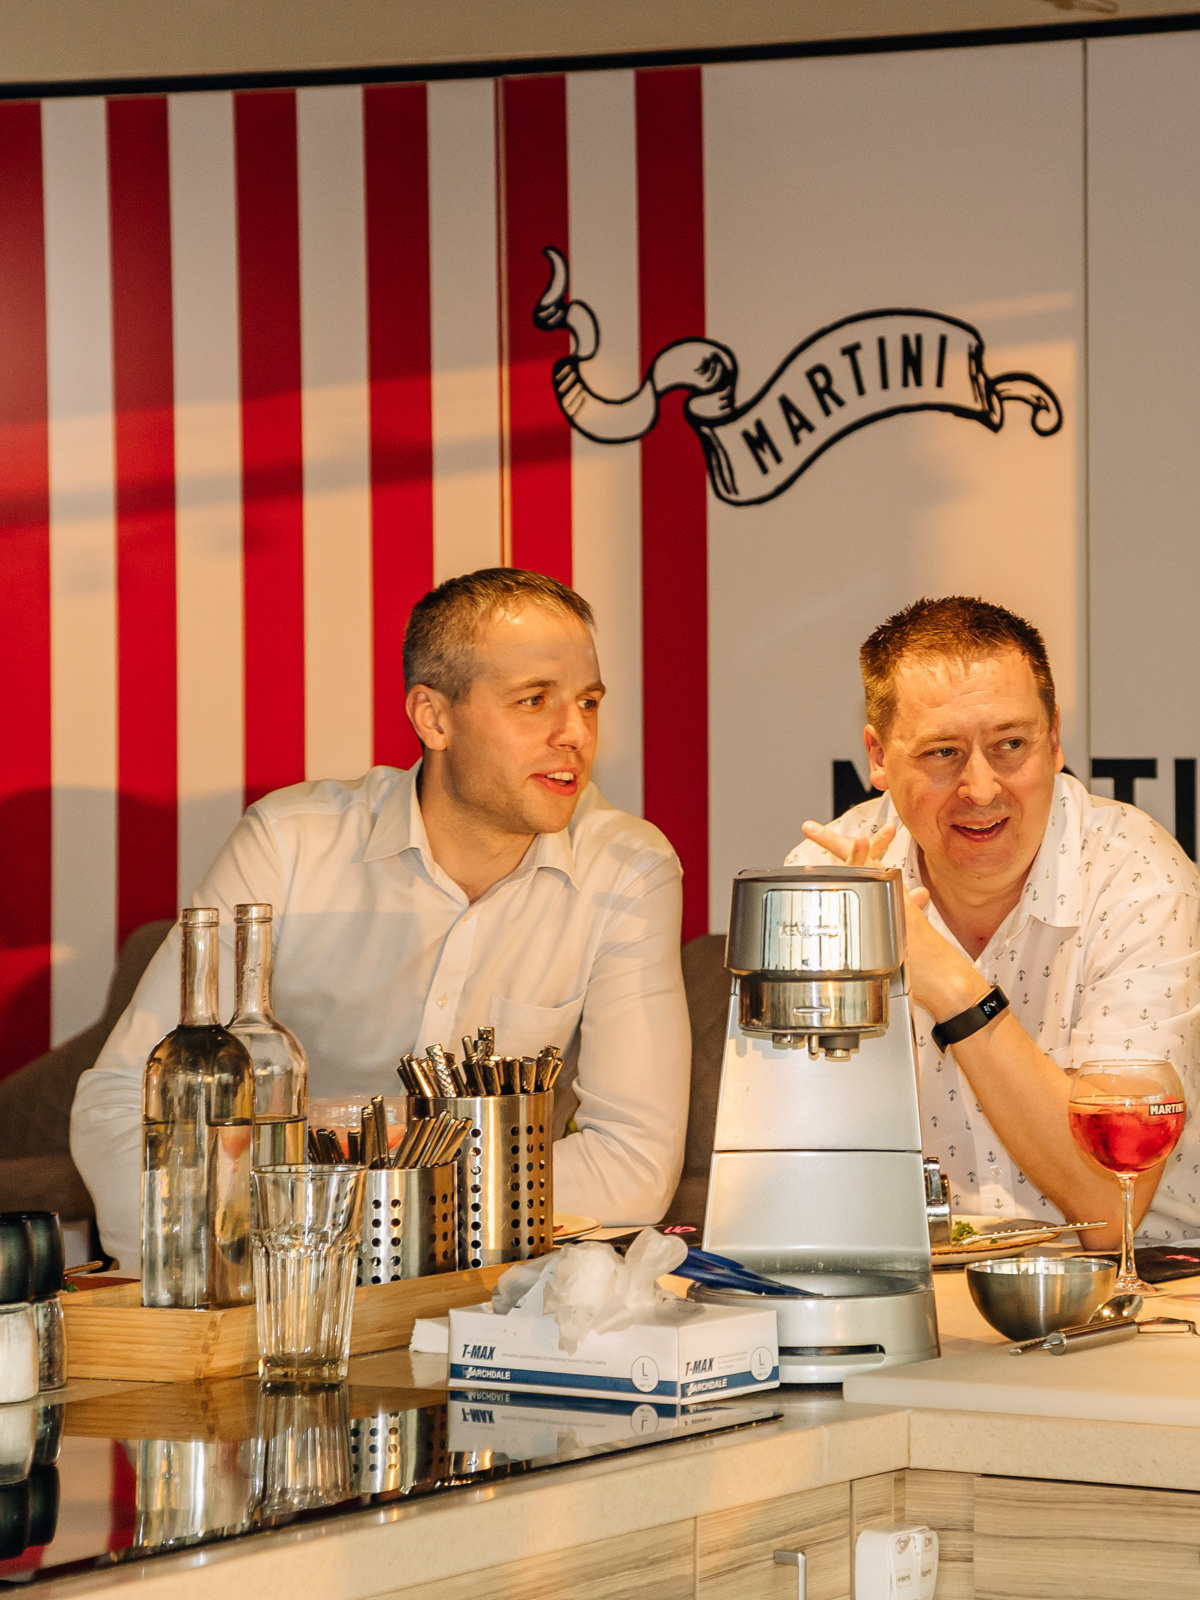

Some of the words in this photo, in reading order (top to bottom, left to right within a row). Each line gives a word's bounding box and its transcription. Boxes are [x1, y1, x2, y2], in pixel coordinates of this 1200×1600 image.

[741, 333, 948, 476] MARTINI
[462, 1344, 496, 1361] T-MAX
[758, 1352, 765, 1366] L
[642, 1362, 649, 1377] L
[685, 1358, 715, 1377] T-MAX
